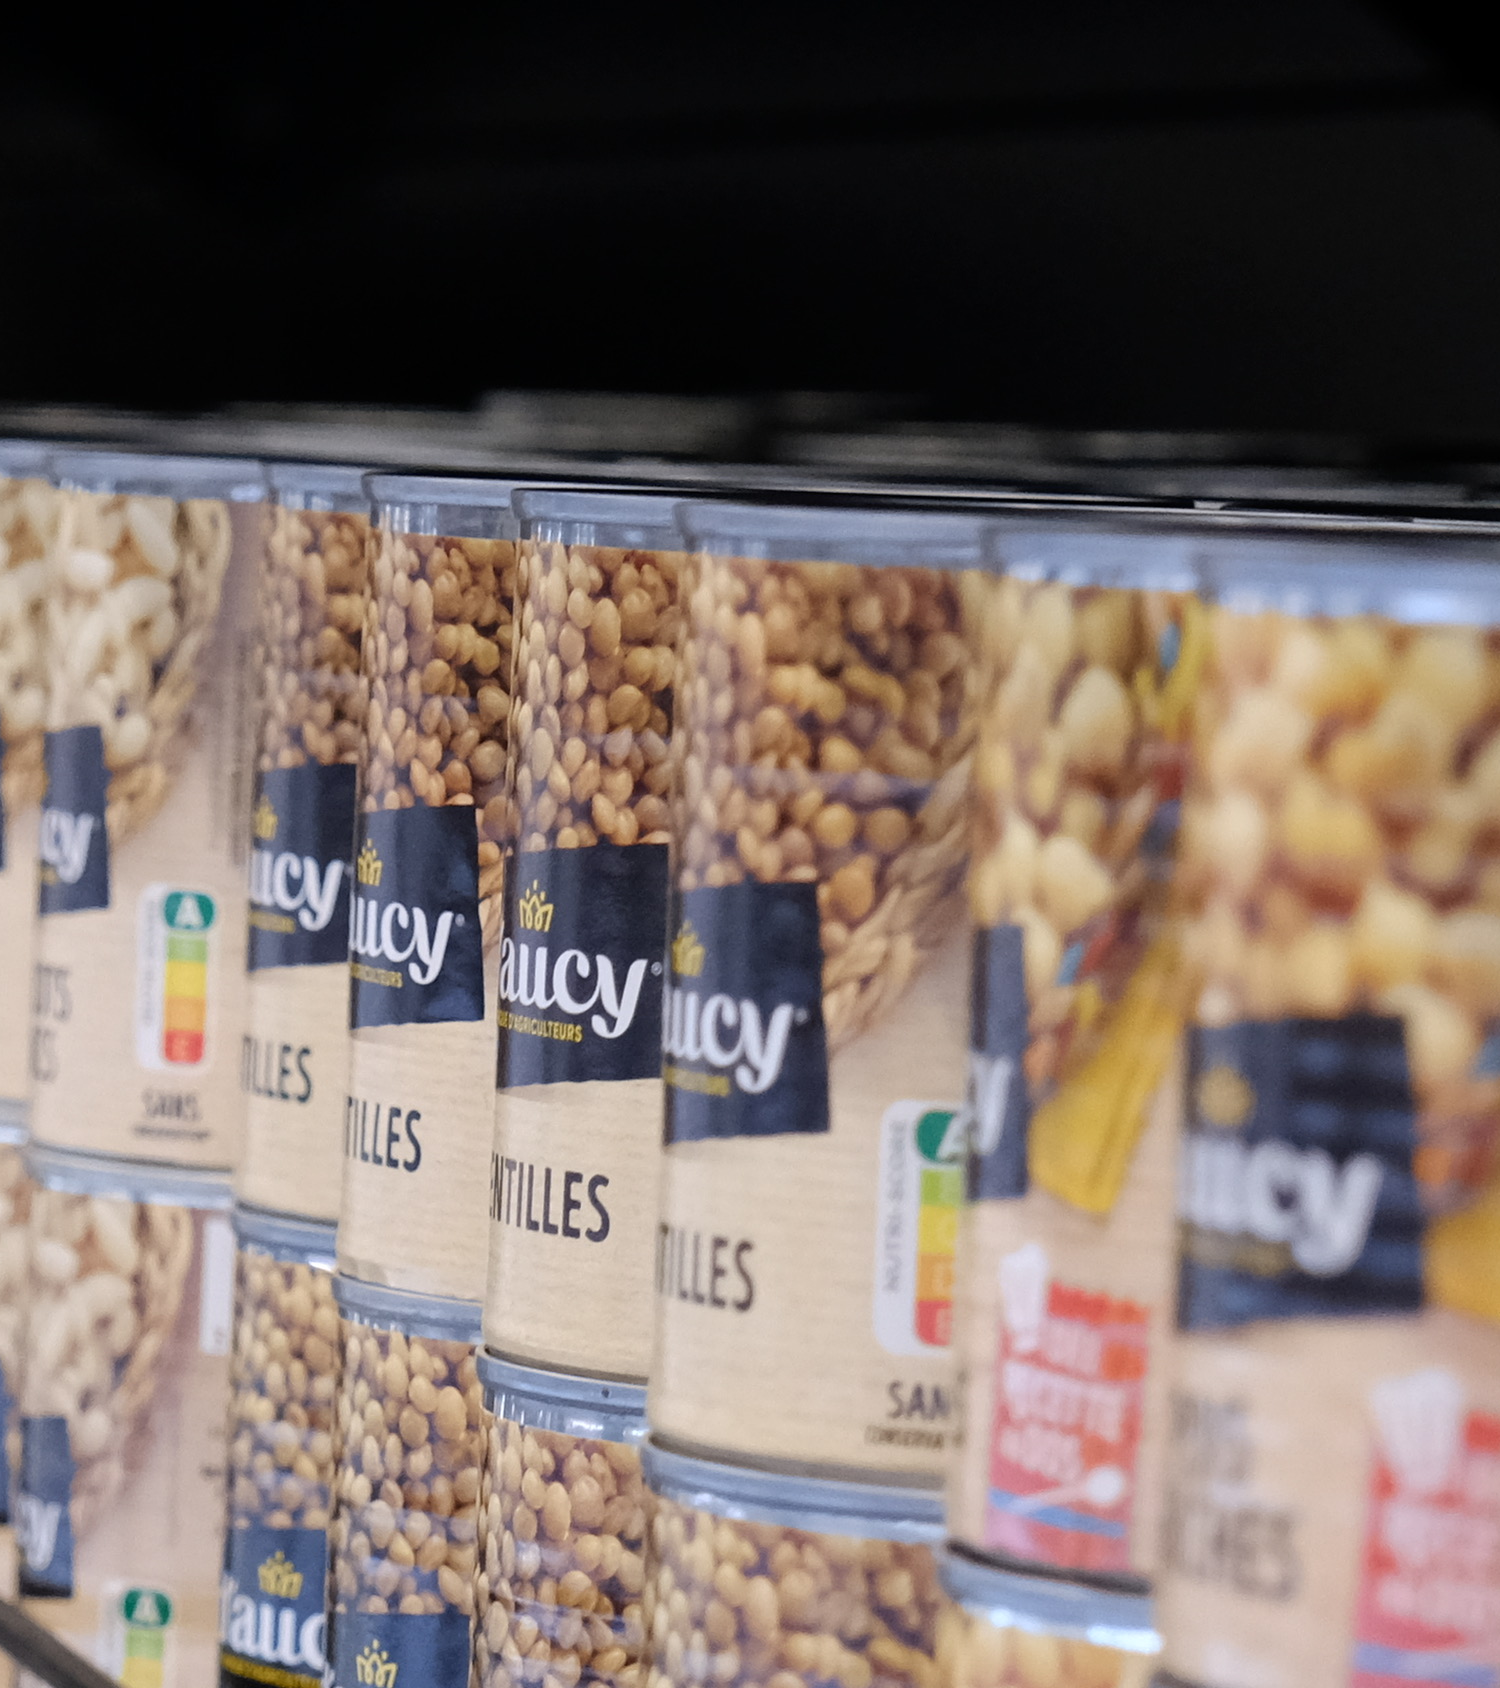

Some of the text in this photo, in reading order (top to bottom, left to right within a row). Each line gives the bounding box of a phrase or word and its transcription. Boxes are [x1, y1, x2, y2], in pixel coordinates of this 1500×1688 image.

[250, 850, 345, 931] ucy
[350, 896, 454, 985] ucy
[500, 936, 648, 1039] aucy
[241, 1034, 312, 1103] TILLES
[662, 985, 795, 1094] ucy
[345, 1096, 422, 1173] TILLES
[654, 1222, 756, 1312] TILLES
